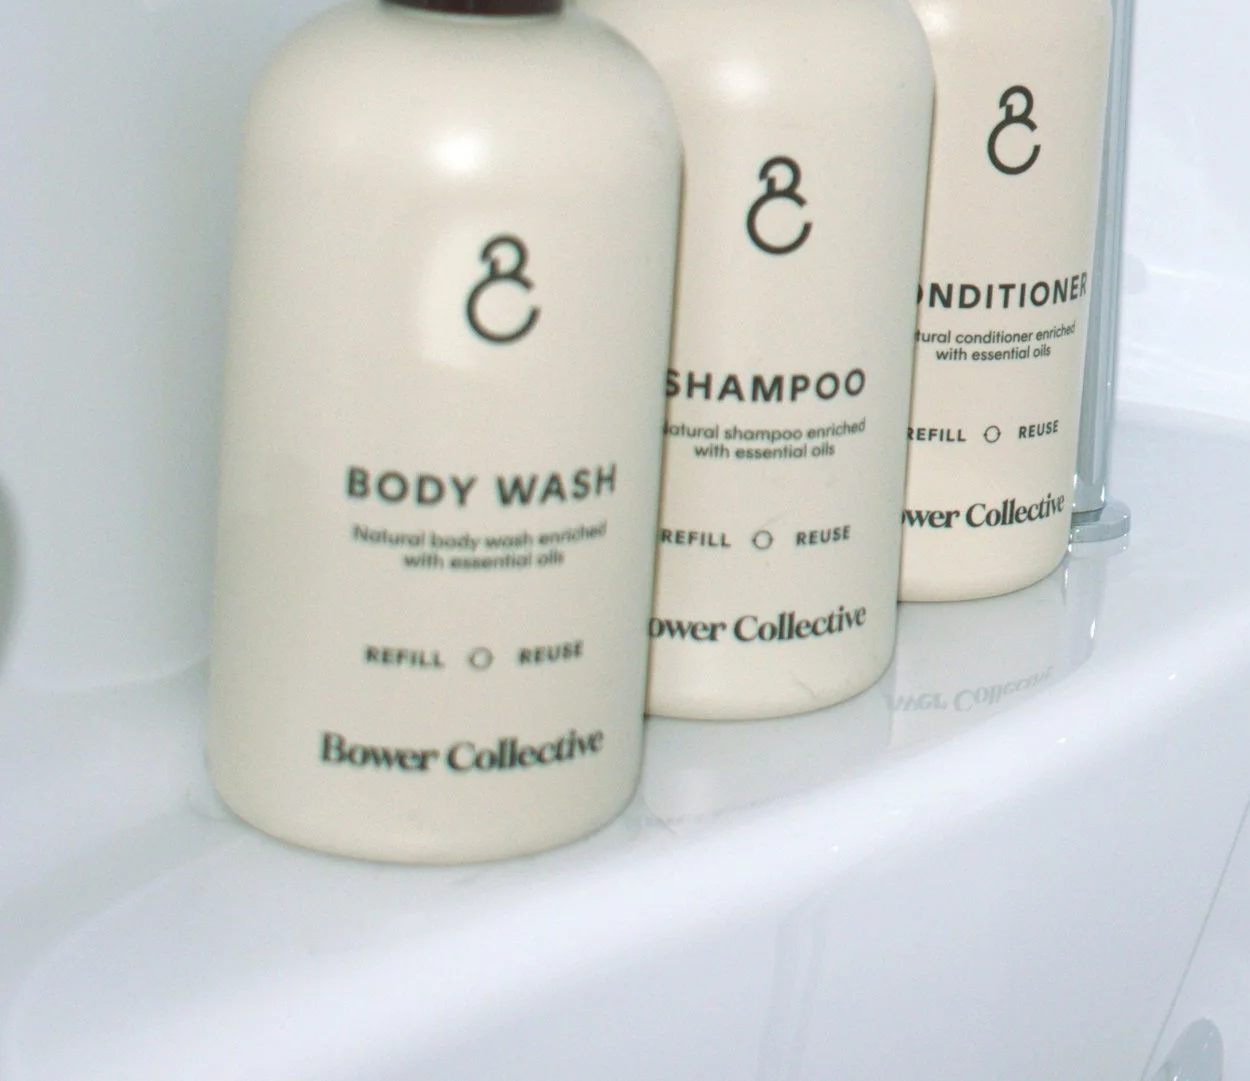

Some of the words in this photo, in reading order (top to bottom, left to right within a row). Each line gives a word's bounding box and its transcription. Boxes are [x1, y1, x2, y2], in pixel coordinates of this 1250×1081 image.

[916, 272, 1088, 310] NDITIONER
[914, 328, 952, 344] tural
[955, 328, 1034, 345] conditioner
[1036, 320, 1077, 342] enriched
[936, 347, 967, 361] with
[971, 345, 1031, 361] essential
[1033, 343, 1052, 358] oils
[665, 368, 867, 403] SHAMPOO
[724, 425, 804, 443] shampoo
[806, 416, 867, 440] enriched
[906, 427, 967, 443] REFILL
[1018, 419, 1060, 440] REUSE
[694, 443, 730, 459] with
[735, 444, 808, 461] essential
[811, 441, 836, 458] oils
[346, 465, 477, 508] BODY
[496, 462, 618, 506] WASH
[902, 508, 962, 529] wer
[966, 492, 1065, 529] Collective
[352, 523, 426, 548] Natural
[430, 530, 481, 553] body
[485, 530, 533, 549] wash
[538, 520, 608, 546] enriched
[659, 527, 732, 549] REFILL
[795, 524, 852, 547] REUSE
[403, 552, 445, 570] with
[449, 550, 533, 571] essential
[537, 549, 566, 567] oils
[648, 616, 728, 642] ower
[733, 605, 868, 643] Collective
[364, 644, 446, 670] REFILL
[515, 639, 585, 666] REUSE
[321, 730, 441, 773] Bower
[445, 728, 605, 773] Collective
